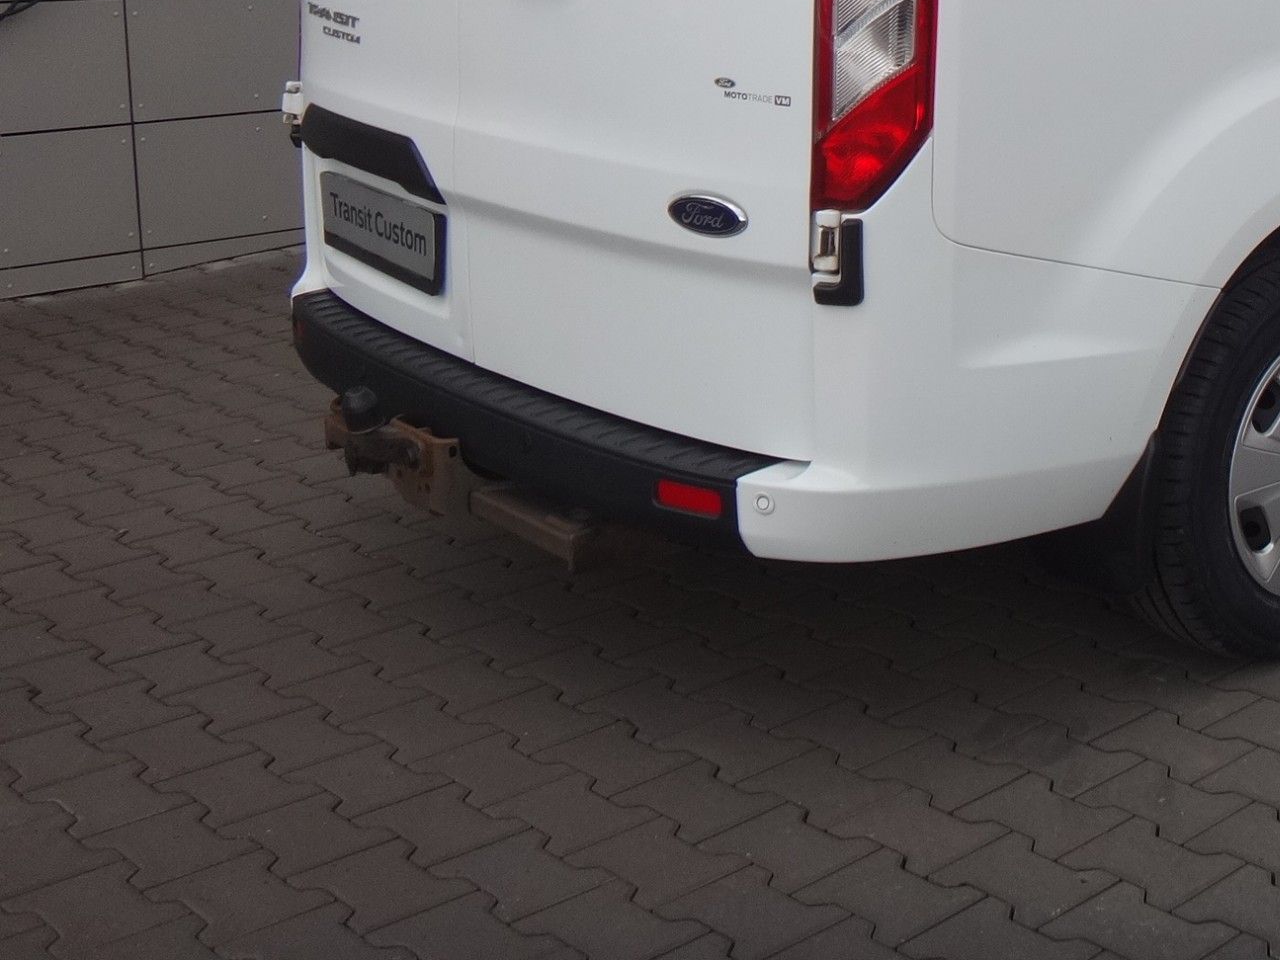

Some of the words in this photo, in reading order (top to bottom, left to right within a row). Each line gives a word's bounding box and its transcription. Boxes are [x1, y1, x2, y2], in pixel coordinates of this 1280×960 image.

[723, 90, 773, 104] MOTOTRADE
[774, 95, 791, 107] VM
[330, 192, 373, 233] Transit
[375, 211, 427, 257] Custom
[681, 201, 725, 228] Ford
